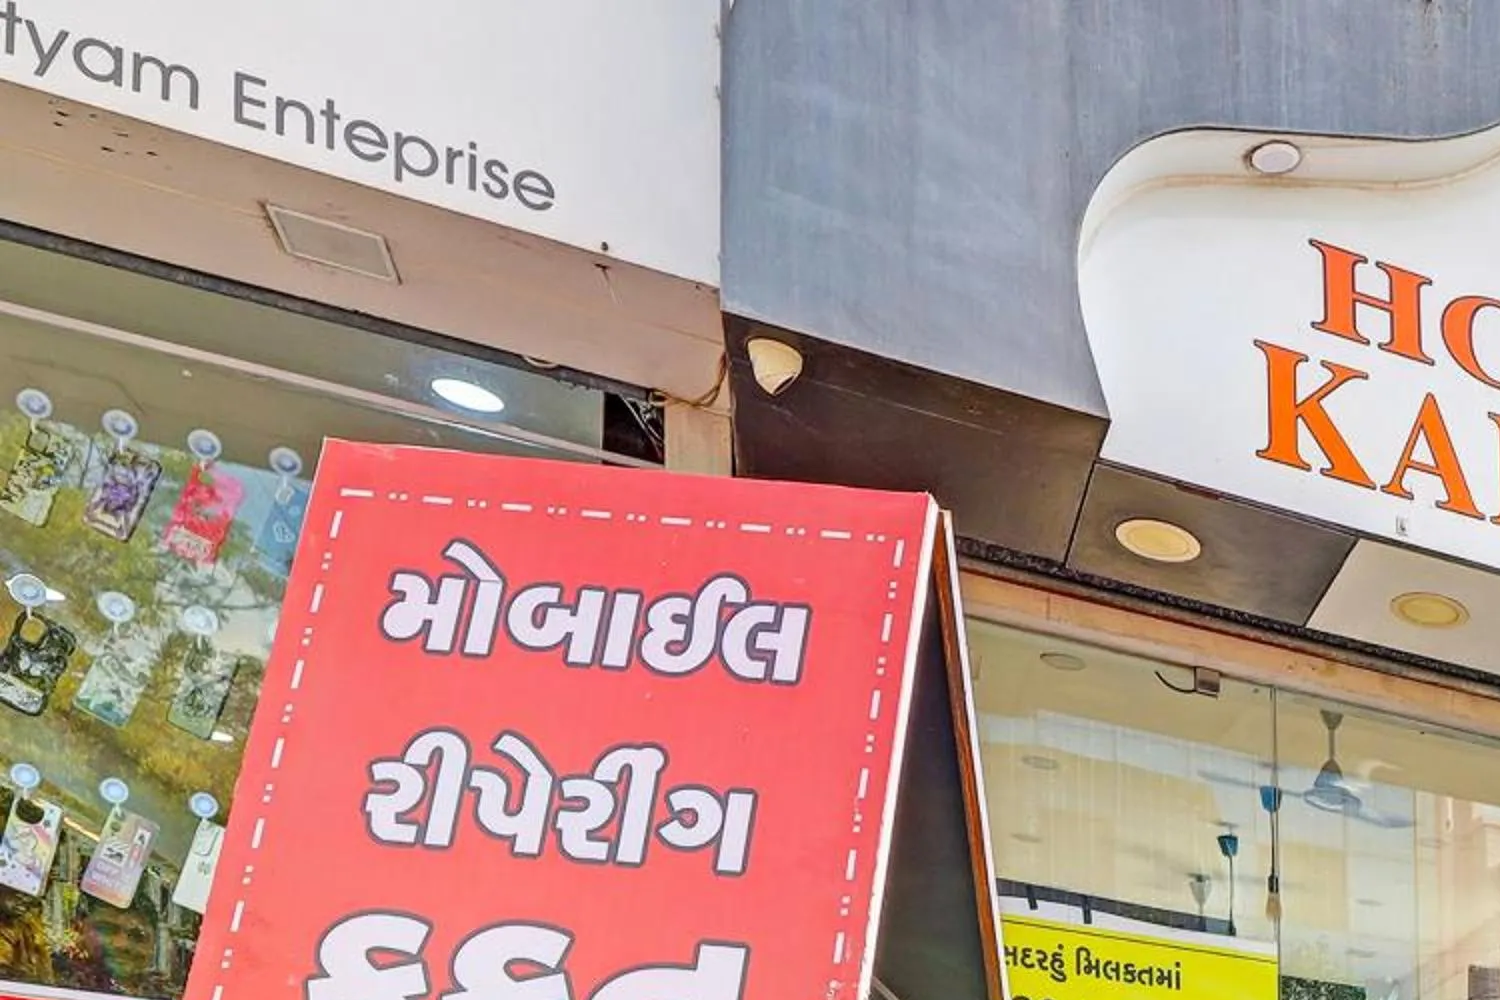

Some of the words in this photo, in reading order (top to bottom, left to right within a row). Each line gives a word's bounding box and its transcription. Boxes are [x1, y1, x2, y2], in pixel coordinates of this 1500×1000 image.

[233, 70, 555, 211] Enteprise
[380, 538, 812, 684] મોબાઈલ
[1075, 945, 1181, 990] મિલકતમાં
